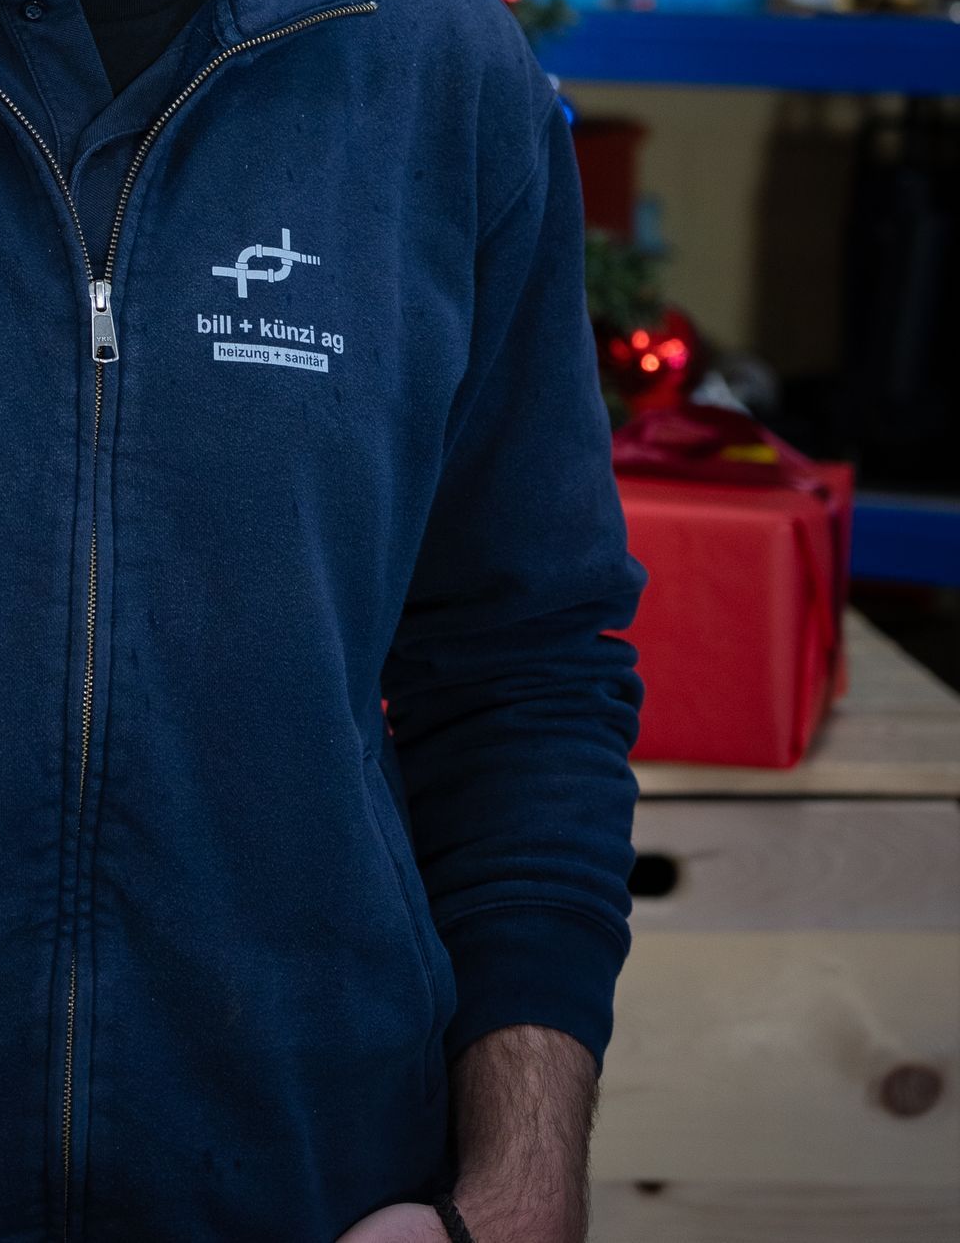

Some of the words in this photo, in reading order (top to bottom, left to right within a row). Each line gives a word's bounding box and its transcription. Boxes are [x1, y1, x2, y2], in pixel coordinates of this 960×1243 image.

[197, 314, 232, 334] bill
[239, 319, 253, 333] +
[260, 318, 315, 344] künzi
[321, 332, 344, 354] ag
[218, 345, 270, 361] heizung
[274, 351, 281, 359] +
[285, 352, 325, 368] sanitär
